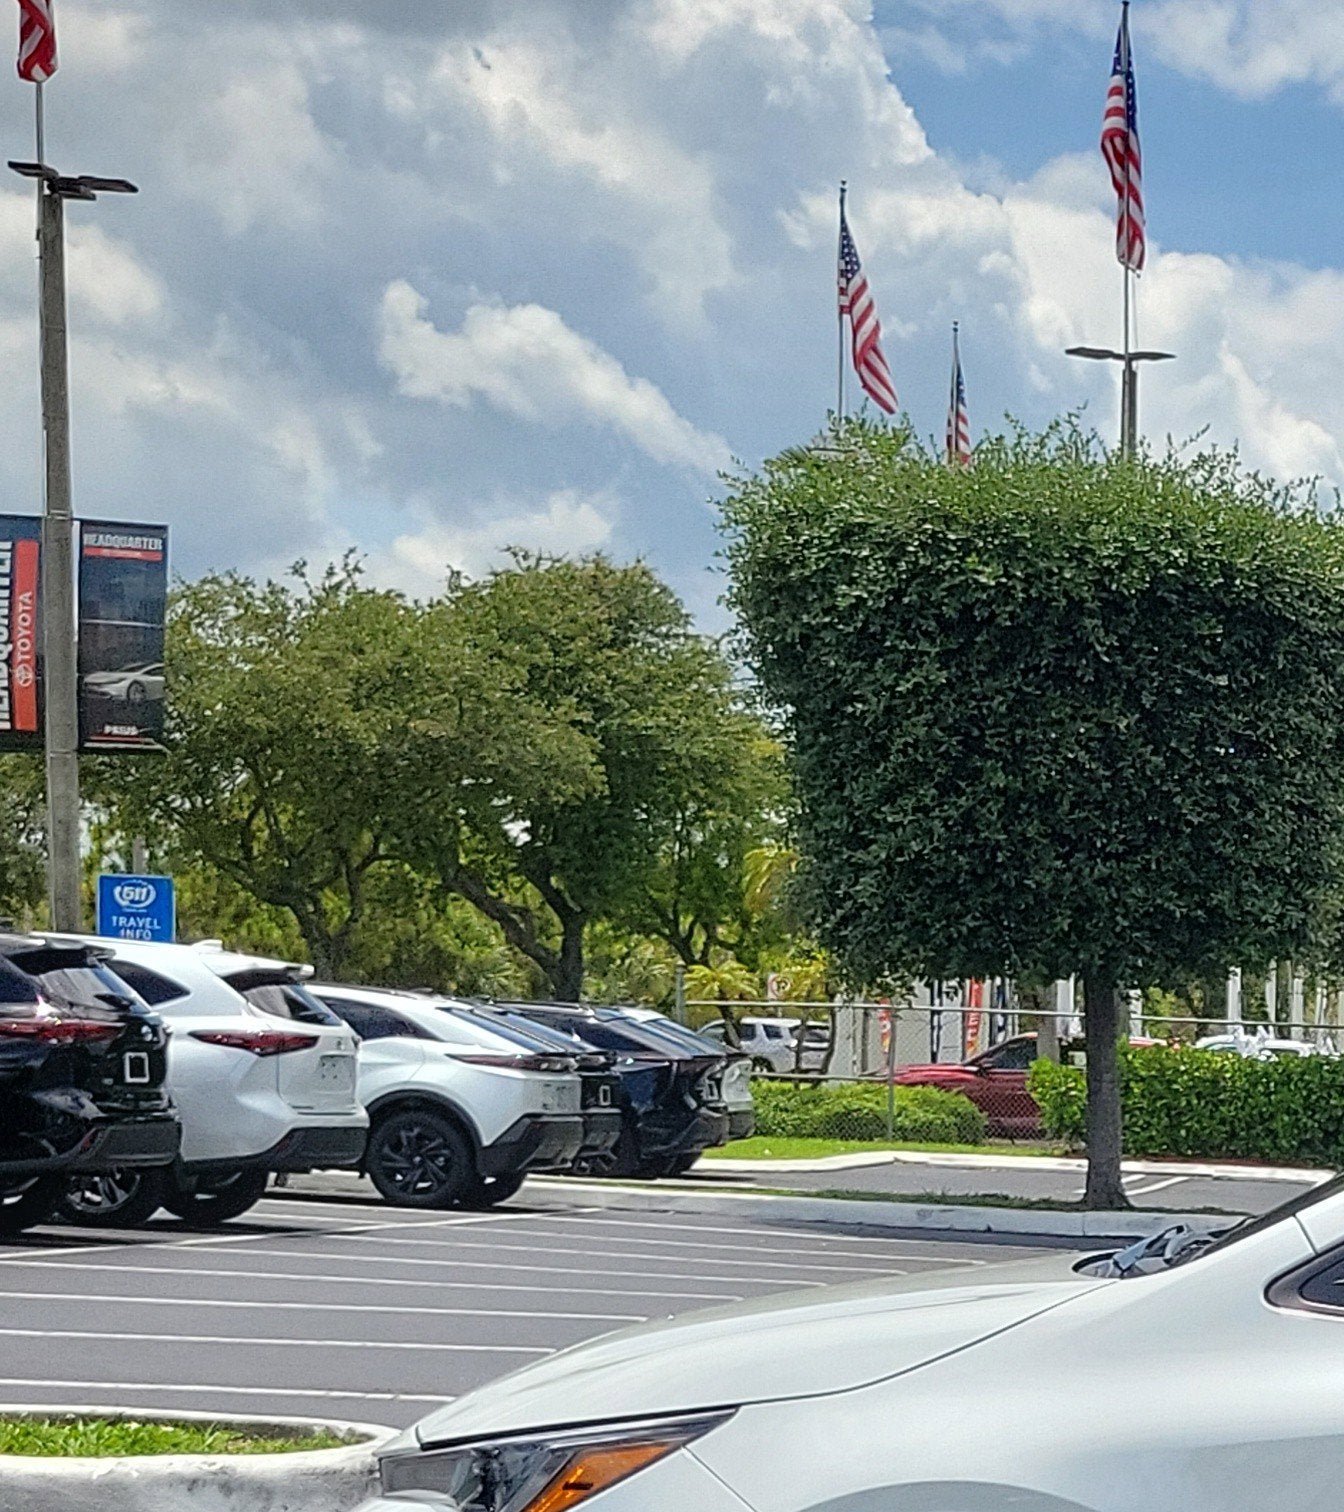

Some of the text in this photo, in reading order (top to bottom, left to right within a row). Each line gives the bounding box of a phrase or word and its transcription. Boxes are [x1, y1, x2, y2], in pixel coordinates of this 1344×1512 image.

[17, 591, 33, 660] TOYOTA
[112, 916, 161, 929] TRAVEL
[120, 928, 152, 940] INFO
